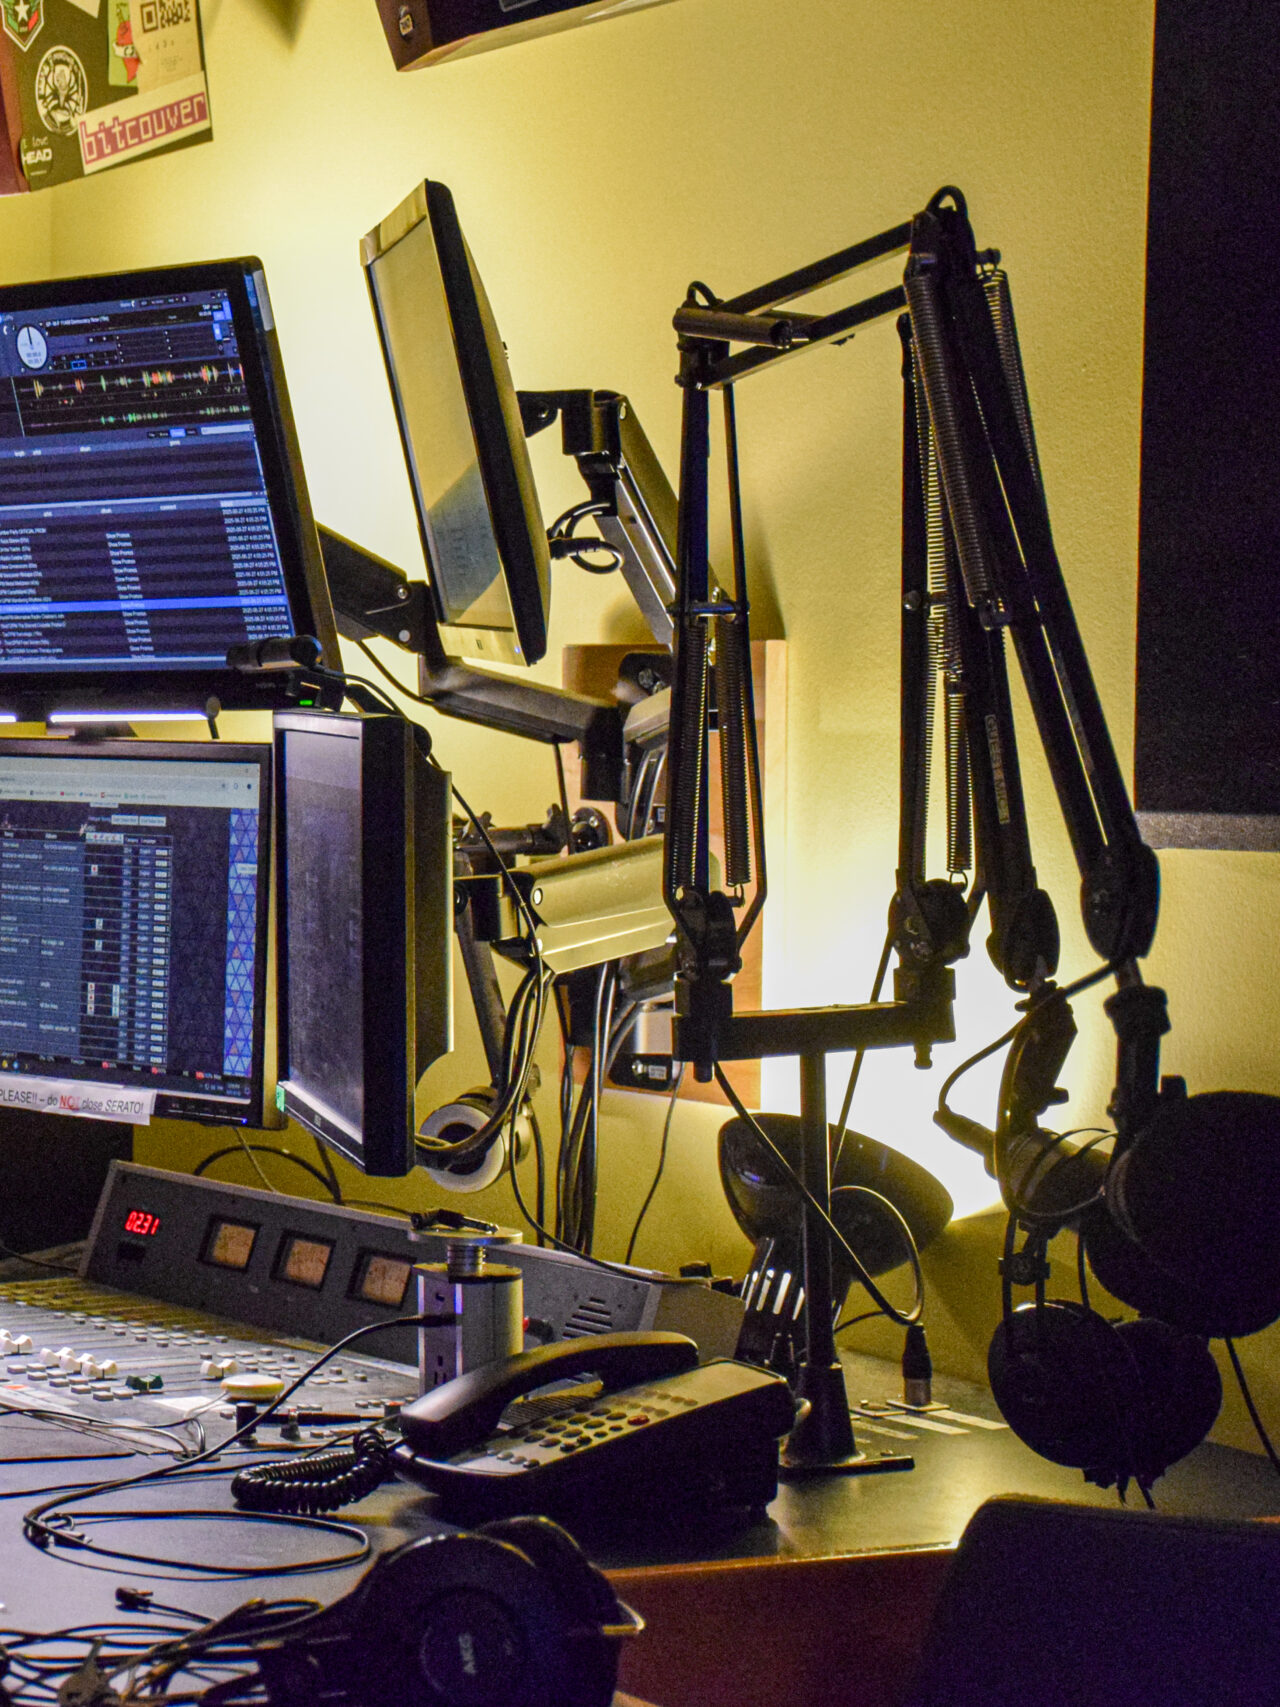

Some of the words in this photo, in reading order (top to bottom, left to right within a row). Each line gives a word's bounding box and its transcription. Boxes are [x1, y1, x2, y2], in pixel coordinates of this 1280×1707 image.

[80, 93, 208, 163] bitcouver
[47, 1095, 58, 1106] do
[82, 1097, 104, 1112] close
[104, 1099, 145, 1114] SERATO!
